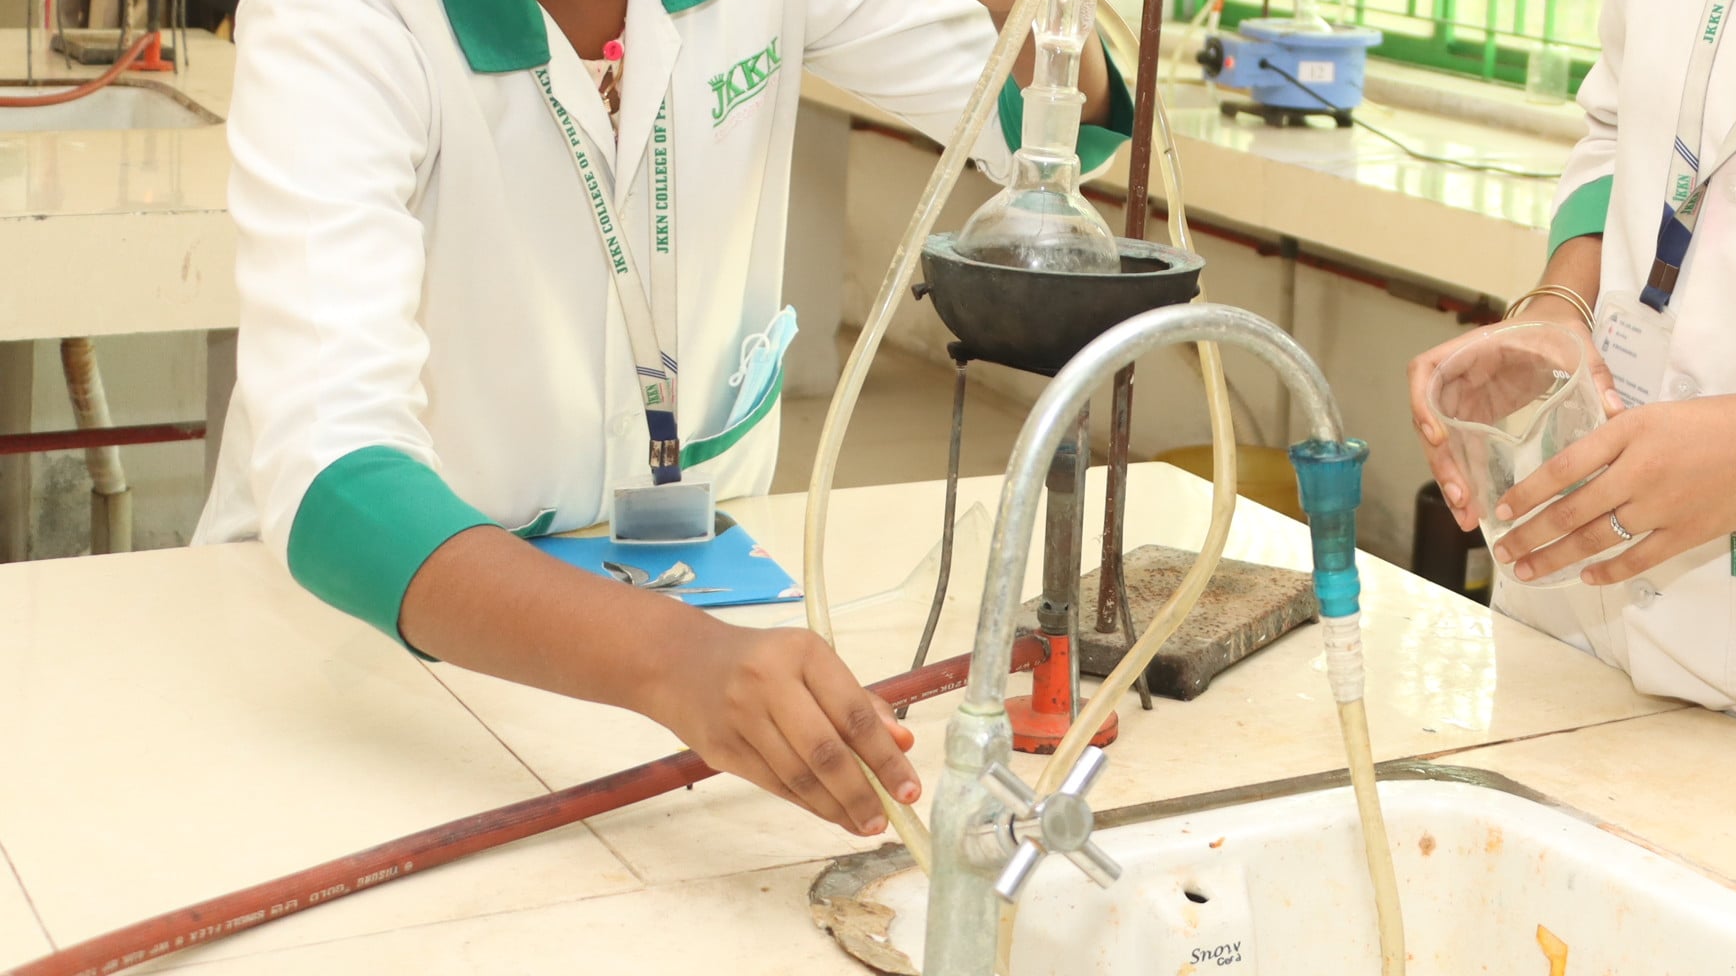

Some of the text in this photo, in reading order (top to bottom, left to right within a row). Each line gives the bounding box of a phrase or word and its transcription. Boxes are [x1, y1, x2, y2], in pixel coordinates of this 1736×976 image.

[1702, 4, 1725, 44] JKKN
[710, 34, 782, 121] JKKN
[654, 124, 668, 144] OF
[575, 149, 590, 170] OF
[654, 145, 669, 212] COLLEGE
[583, 170, 614, 234] COLLEGE
[1672, 174, 1691, 202] JKKN
[656, 214, 670, 254] JKKN
[606, 235, 629, 275] JKKN
